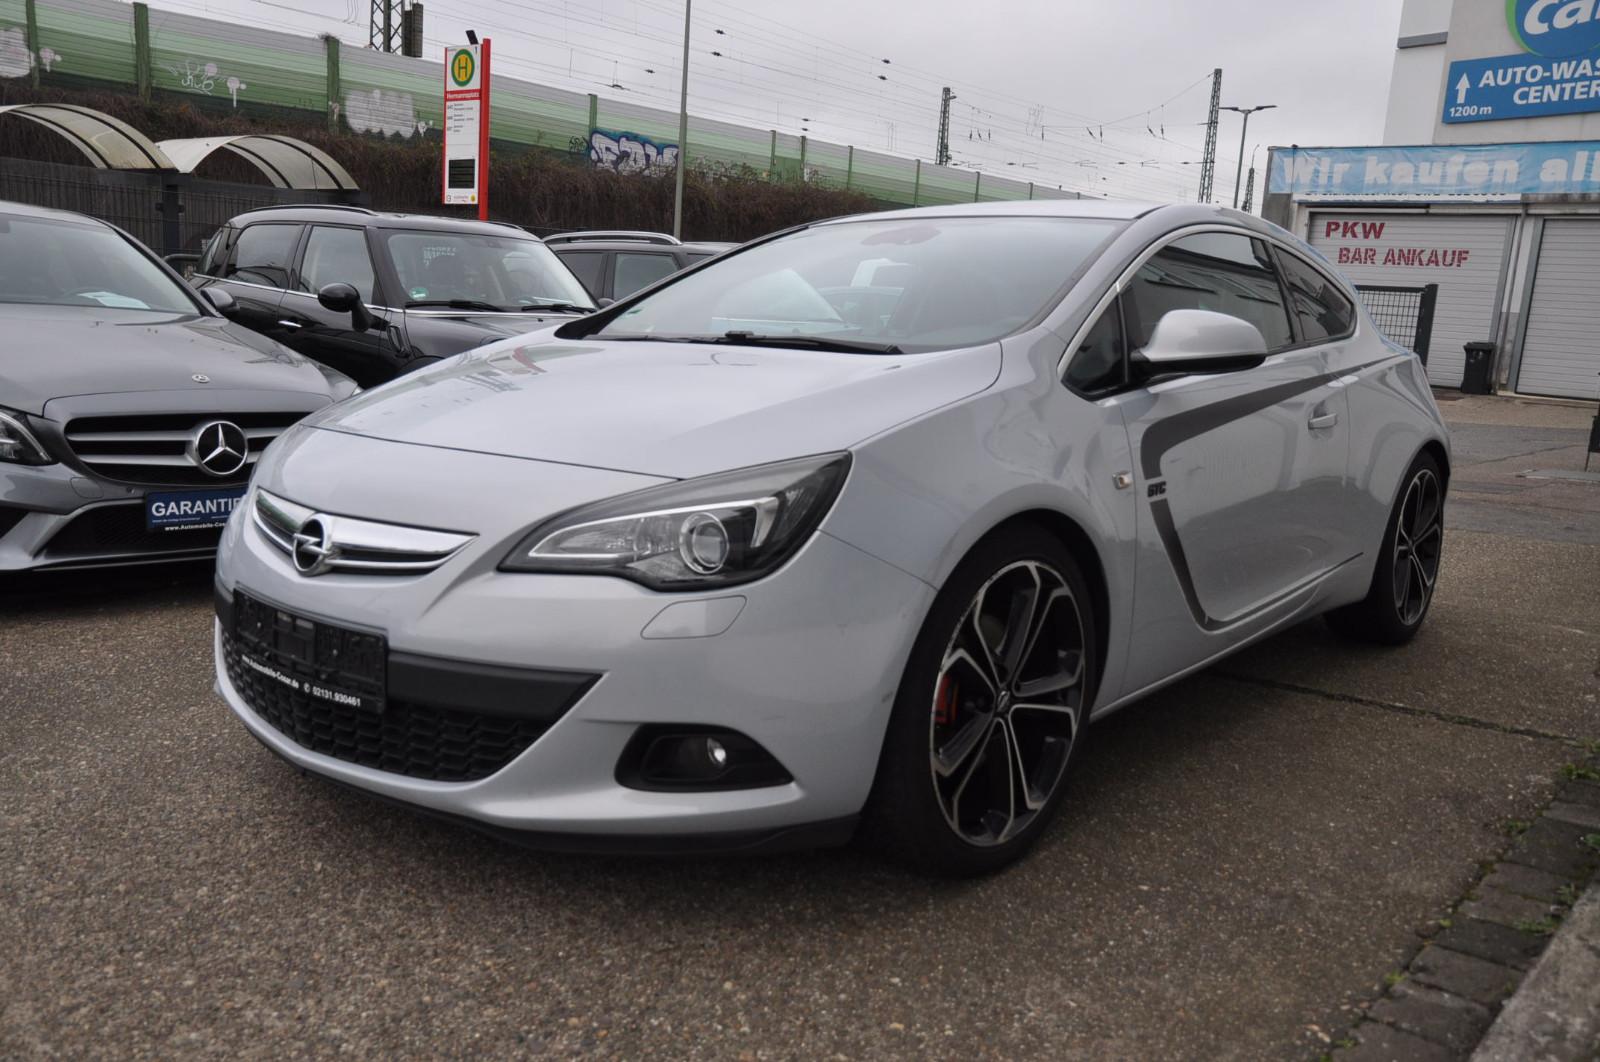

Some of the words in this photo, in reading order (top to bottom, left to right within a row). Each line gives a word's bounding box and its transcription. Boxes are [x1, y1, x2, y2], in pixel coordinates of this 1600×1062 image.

[1524, 0, 1600, 35] Ca
[458, 57, 468, 79] H
[1513, 79, 1600, 105] CENTER
[1449, 105, 1478, 118] 1200
[1479, 106, 1492, 115] m
[1283, 155, 1352, 185] Wir
[1364, 153, 1520, 185] kaufen
[1325, 221, 1386, 240] PKW
[1337, 247, 1377, 265] BAR
[1382, 248, 1470, 268] ANKAUF
[1147, 481, 1167, 498] GTC
